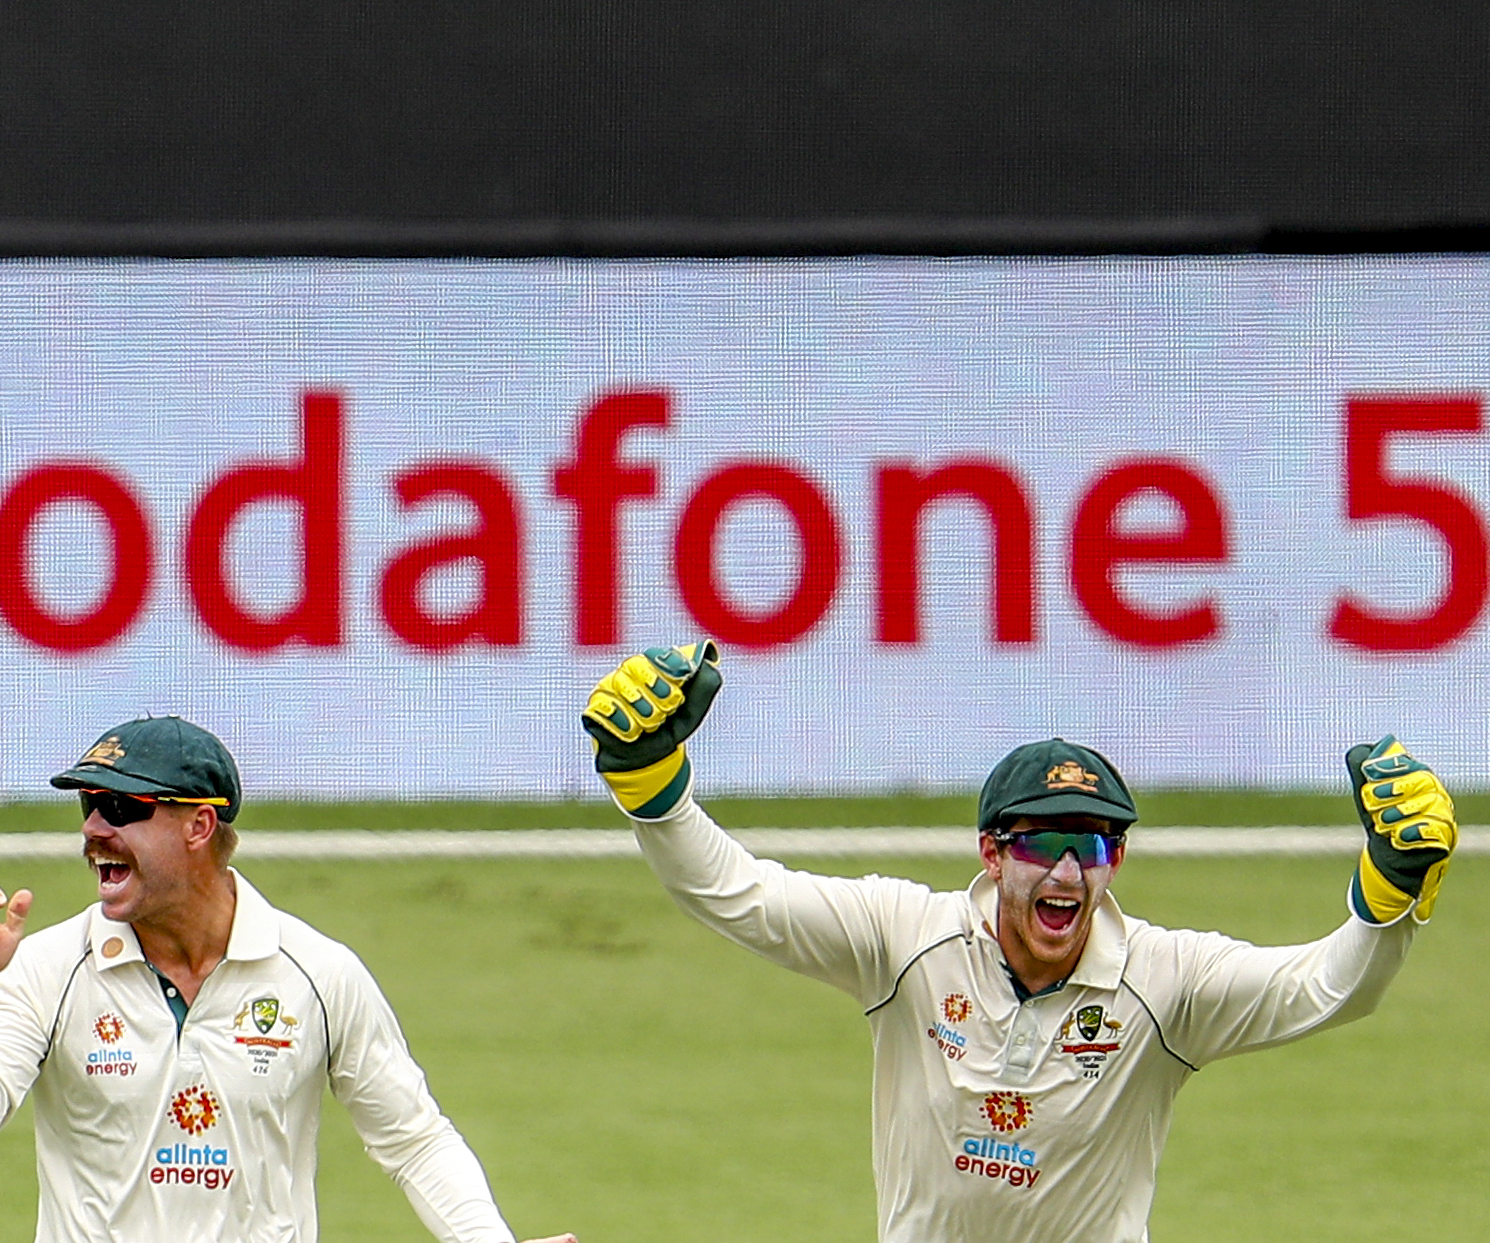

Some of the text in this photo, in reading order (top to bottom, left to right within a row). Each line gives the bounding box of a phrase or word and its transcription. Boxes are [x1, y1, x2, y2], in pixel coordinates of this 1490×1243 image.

[1327, 394, 1490, 655] 5
[87, 1049, 133, 1063] alinta
[927, 1028, 968, 1062] eergy
[85, 1061, 138, 1077] energy
[156, 1142, 228, 1166] alinta
[963, 1137, 1037, 1168] alinta
[149, 1166, 235, 1190] energy
[954, 1154, 1042, 1189] energy
